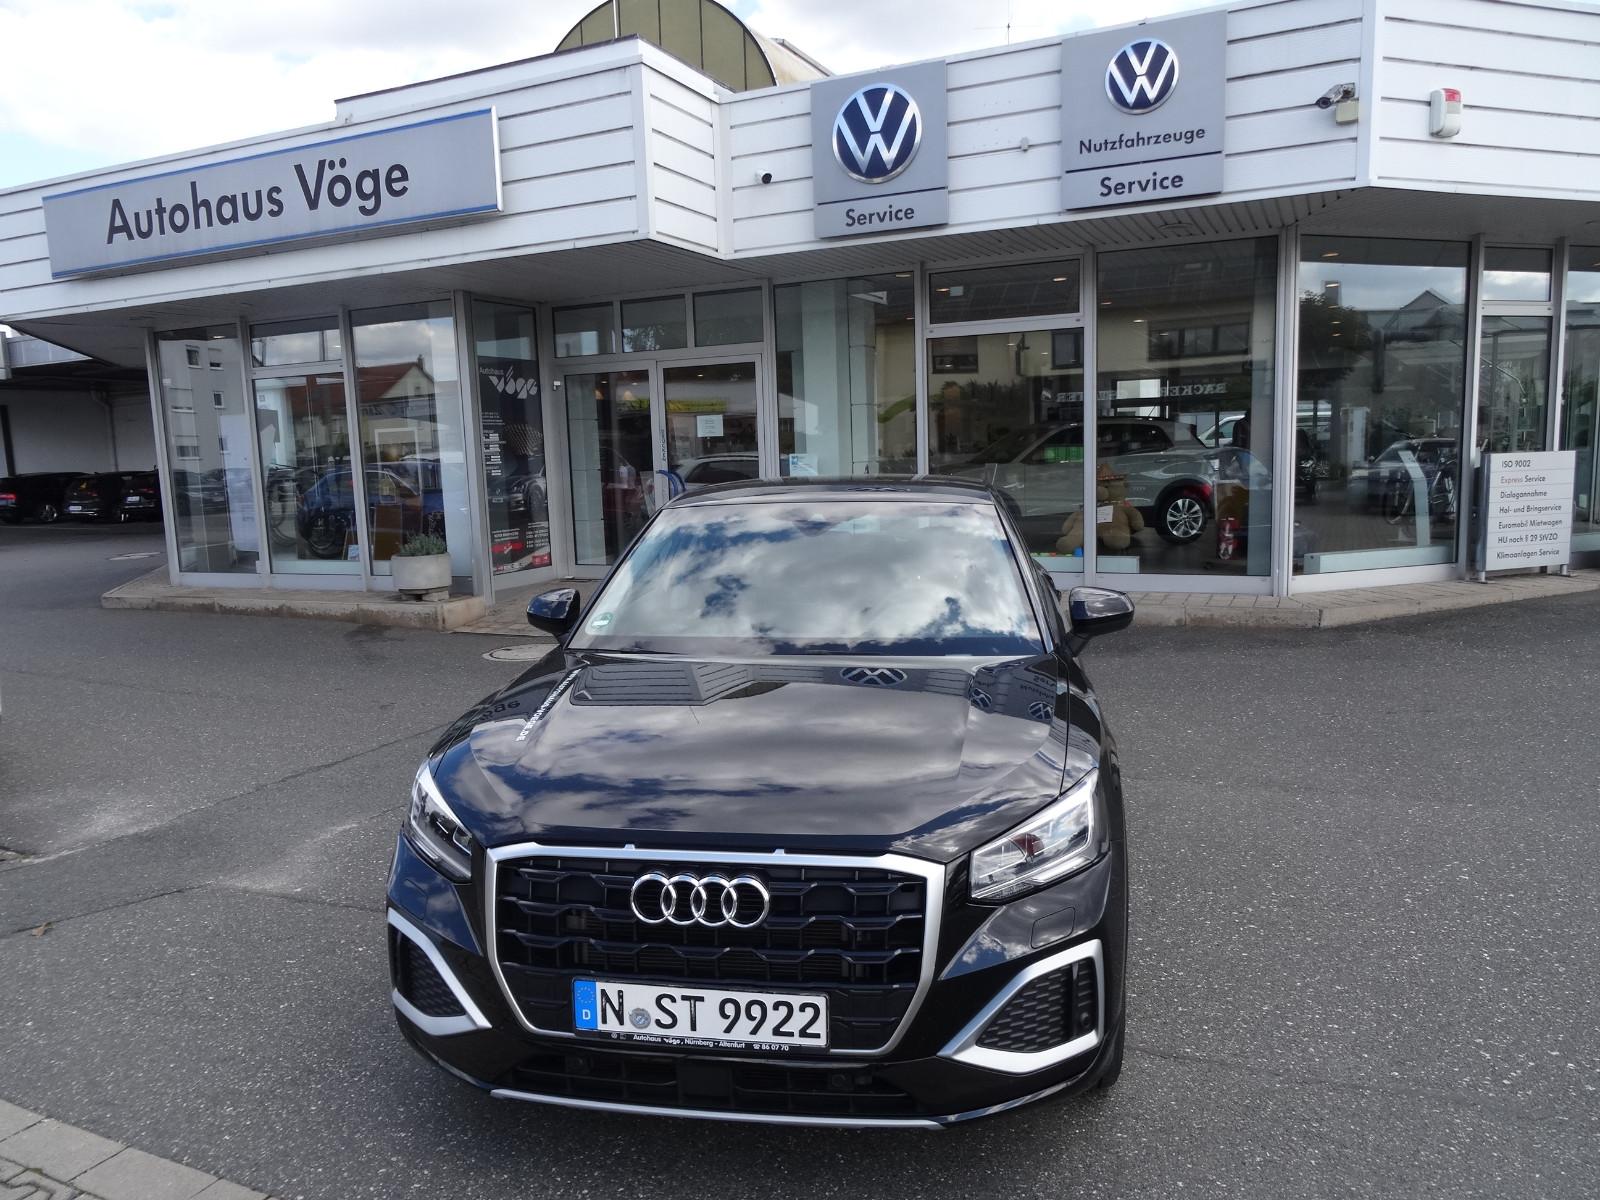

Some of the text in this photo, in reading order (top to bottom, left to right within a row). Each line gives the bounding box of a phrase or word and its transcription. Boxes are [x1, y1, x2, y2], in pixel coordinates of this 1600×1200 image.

[1079, 128, 1206, 155] Nutzfahrzeuge
[1100, 171, 1184, 197] Service
[106, 157, 410, 245] Autohaus Vöge
[845, 204, 915, 227] Service
[1502, 460, 1531, 468] ISO 9002
[1501, 474, 1546, 485] Express Service
[1500, 489, 1548, 500] Dialogannahme
[1514, 504, 1525, 513] und
[1526, 503, 1562, 514] Bringservice
[1498, 519, 1562, 530] Euromobil Mietwagen
[1497, 536, 1508, 544] HU
[1509, 535, 1524, 543] nach
[1530, 534, 1538, 542] 29
[1539, 532, 1559, 542] StVZO
[1496, 548, 1560, 560] Klimaanlagen Service
[582, 1009, 592, 1020] D
[600, 988, 822, 1039] N ST 9922
[632, 1032, 661, 1043] Autohaus
[685, 1036, 713, 1048] Nürnberg
[719, 1040, 746, 1049] Altenfurt
